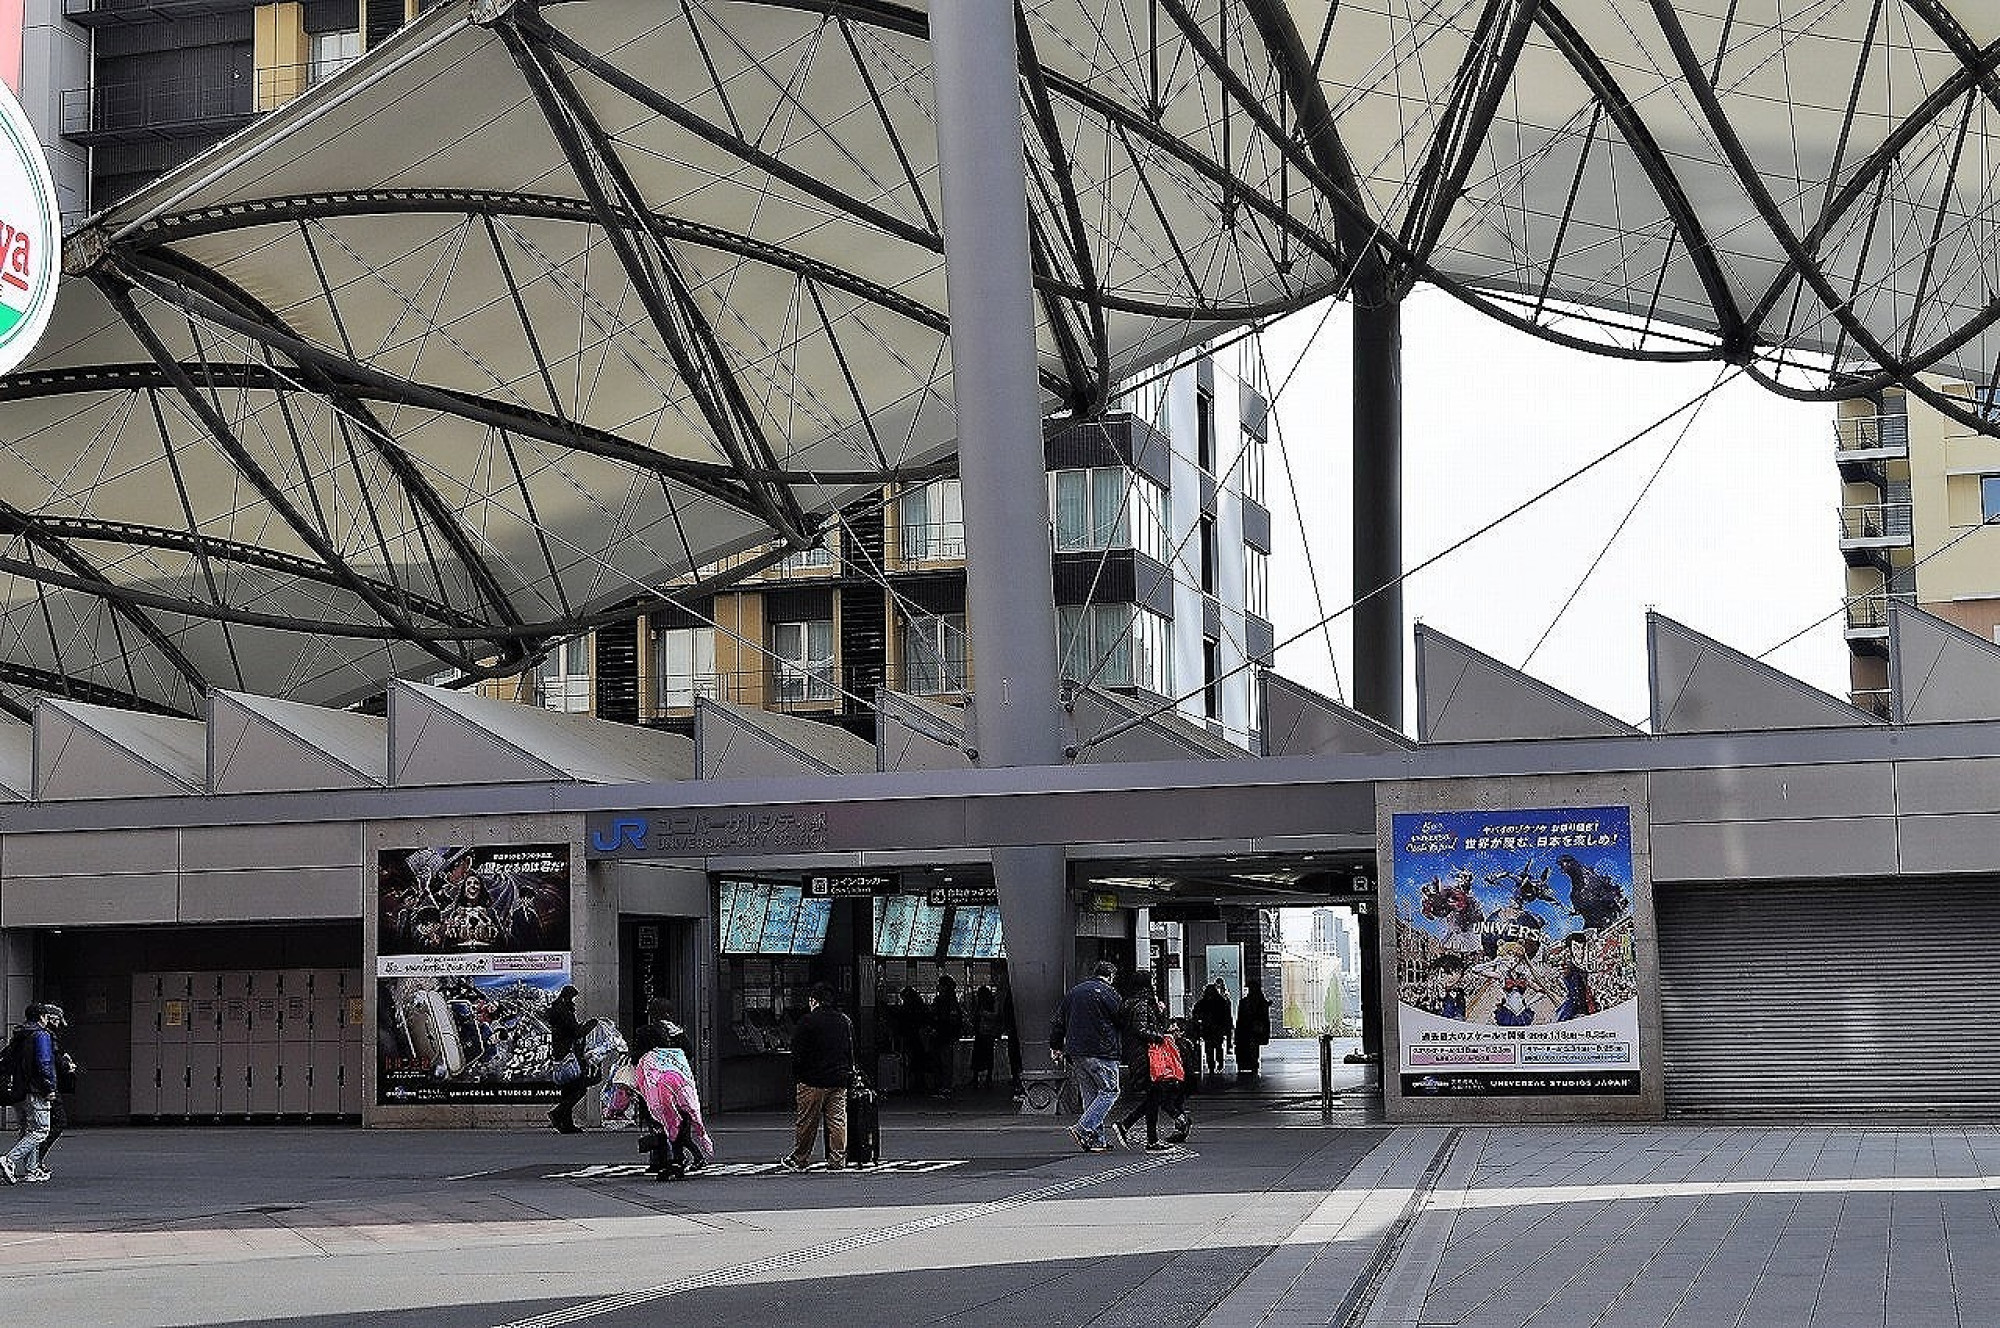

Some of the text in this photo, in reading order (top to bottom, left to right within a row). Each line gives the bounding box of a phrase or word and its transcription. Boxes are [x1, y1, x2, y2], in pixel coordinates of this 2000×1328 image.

[593, 818, 649, 850] JR
[830, 877, 890, 887] コインロッカー
[1594, 1077, 1627, 1087] JAPAN
[535, 1089, 562, 1097] JAPAN
